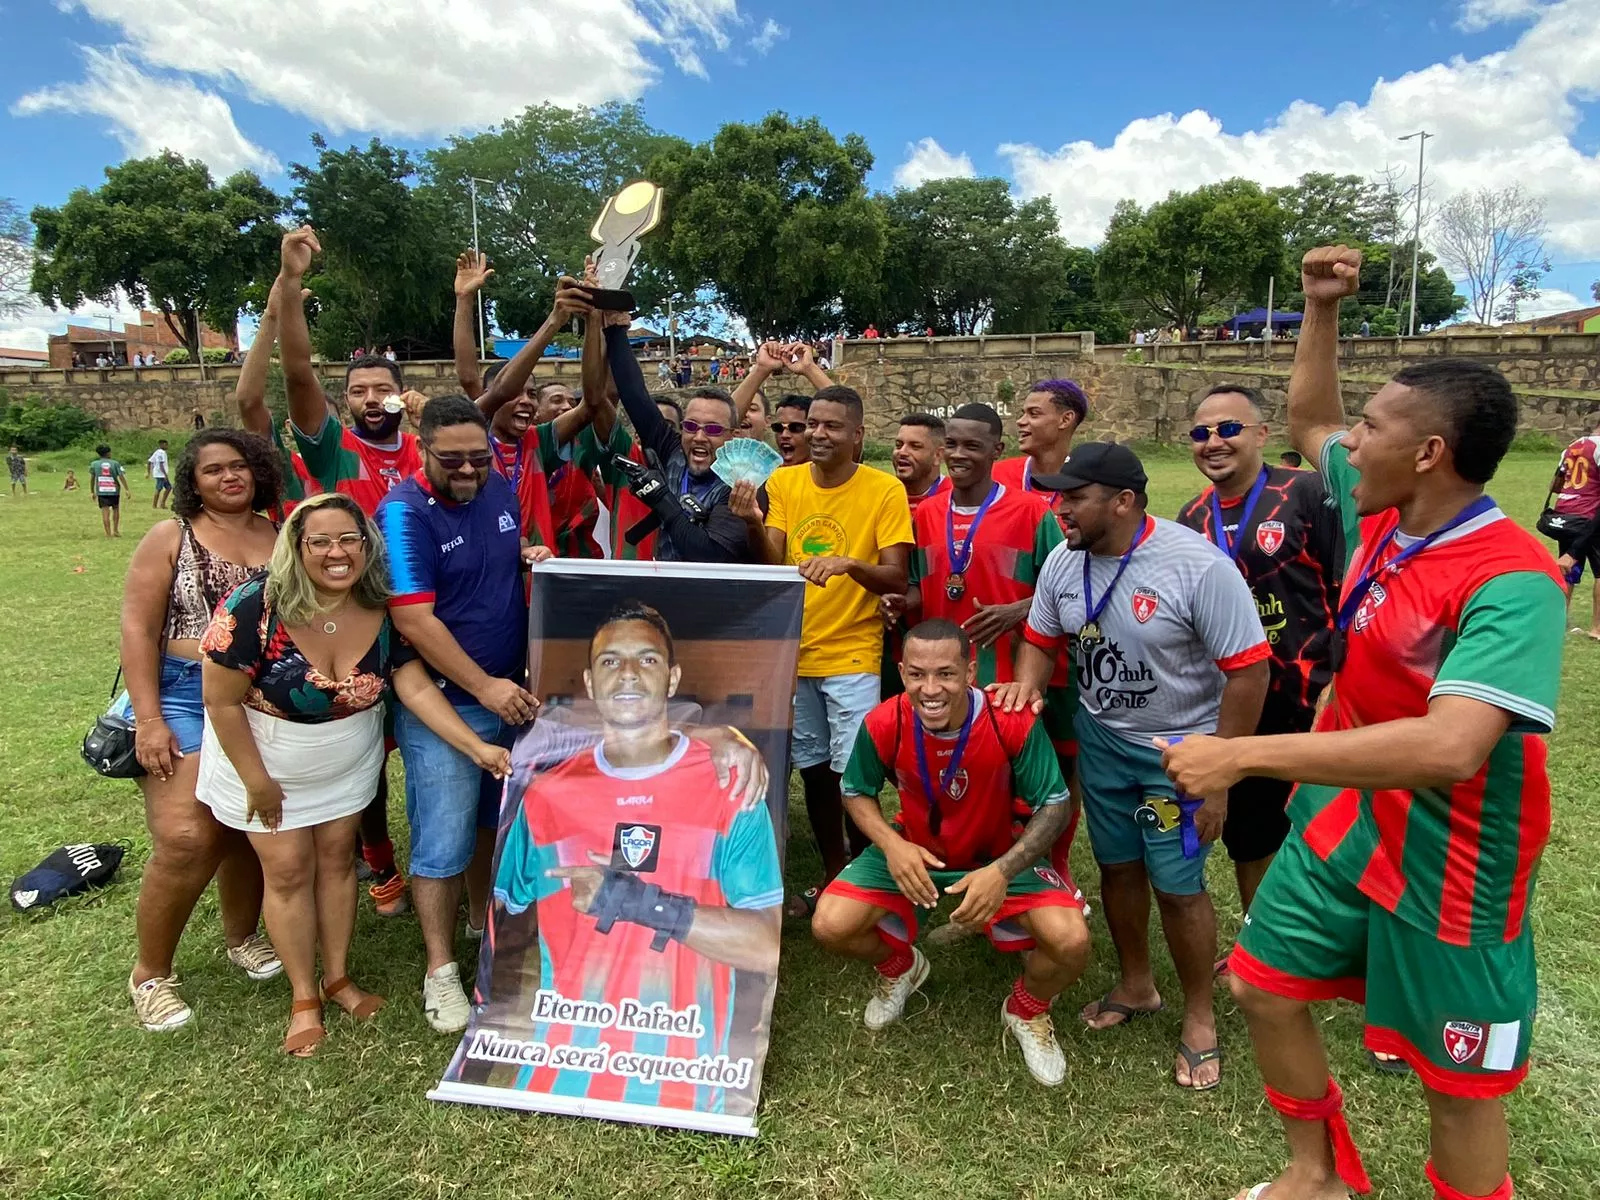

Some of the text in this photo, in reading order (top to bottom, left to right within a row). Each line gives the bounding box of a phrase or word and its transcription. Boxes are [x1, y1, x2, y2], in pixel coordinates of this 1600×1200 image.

[1096, 685, 1158, 711] Corte
[535, 993, 702, 1034] Eterno Rafael.
[1449, 1021, 1480, 1033] SPARTA
[471, 1033, 749, 1085] Nunca será esquecido!
